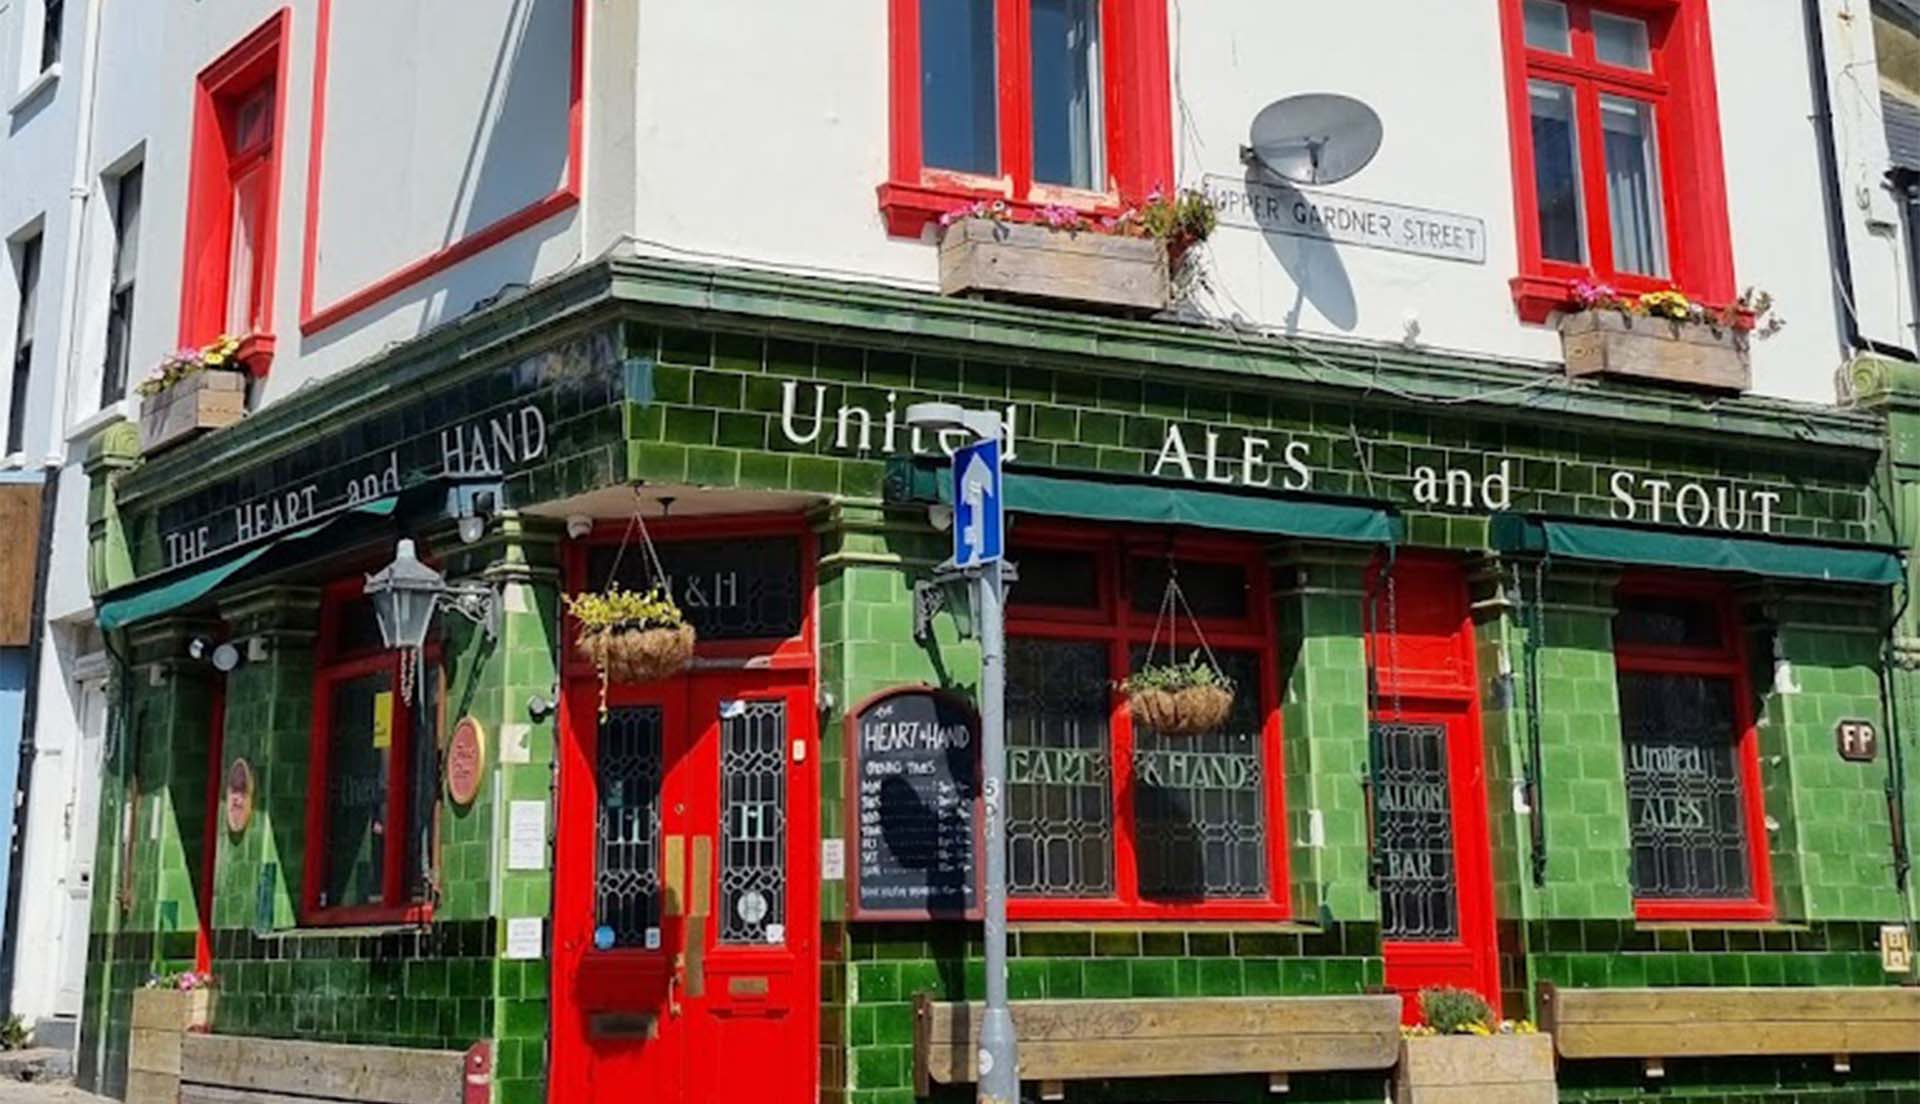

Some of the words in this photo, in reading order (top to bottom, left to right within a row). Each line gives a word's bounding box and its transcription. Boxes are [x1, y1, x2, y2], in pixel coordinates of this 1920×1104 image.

[1214, 191, 1279, 220] UPPER
[1294, 203, 1391, 238] GARDNER
[1403, 219, 1477, 250] STREET
[167, 526, 208, 568] THE
[235, 484, 318, 542] HEART
[346, 450, 402, 504] and
[441, 405, 545, 475] HAND
[1152, 424, 1310, 491] ALES
[1413, 460, 1511, 511] and
[1609, 471, 1780, 533] STOUT
[715, 571, 737, 607] H
[865, 721, 920, 752] HEART
[1842, 725, 1873, 753] FP
[1010, 750, 1091, 784] EART
[1168, 753, 1249, 788] HAND
[1630, 744, 1701, 772] United
[1379, 784, 1444, 812] ALOON
[1641, 798, 1704, 828] ALES
[1388, 852, 1432, 880] BAR
